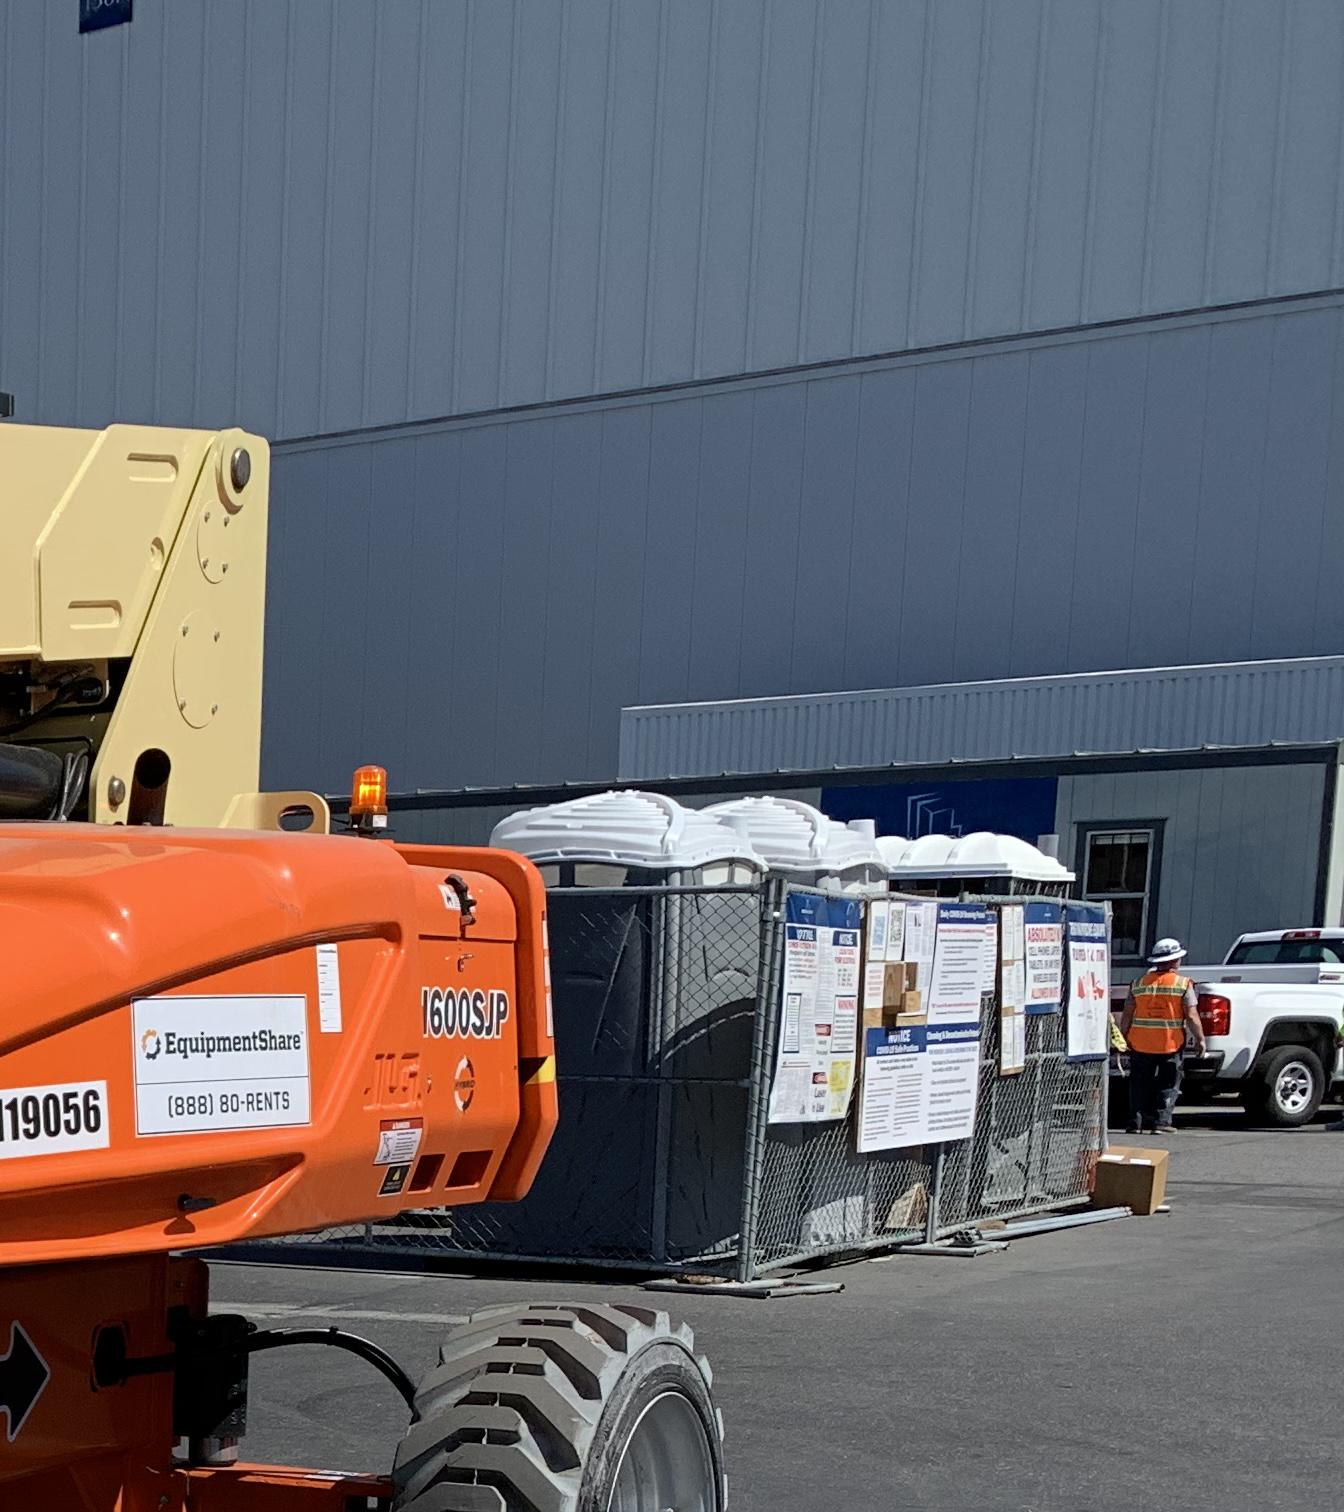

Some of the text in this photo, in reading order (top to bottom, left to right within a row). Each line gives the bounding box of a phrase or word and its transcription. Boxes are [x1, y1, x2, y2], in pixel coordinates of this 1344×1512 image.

[164, 1028, 302, 1060] EquipmentShare
[167, 1090, 291, 1118] (888) 80-RENTS
